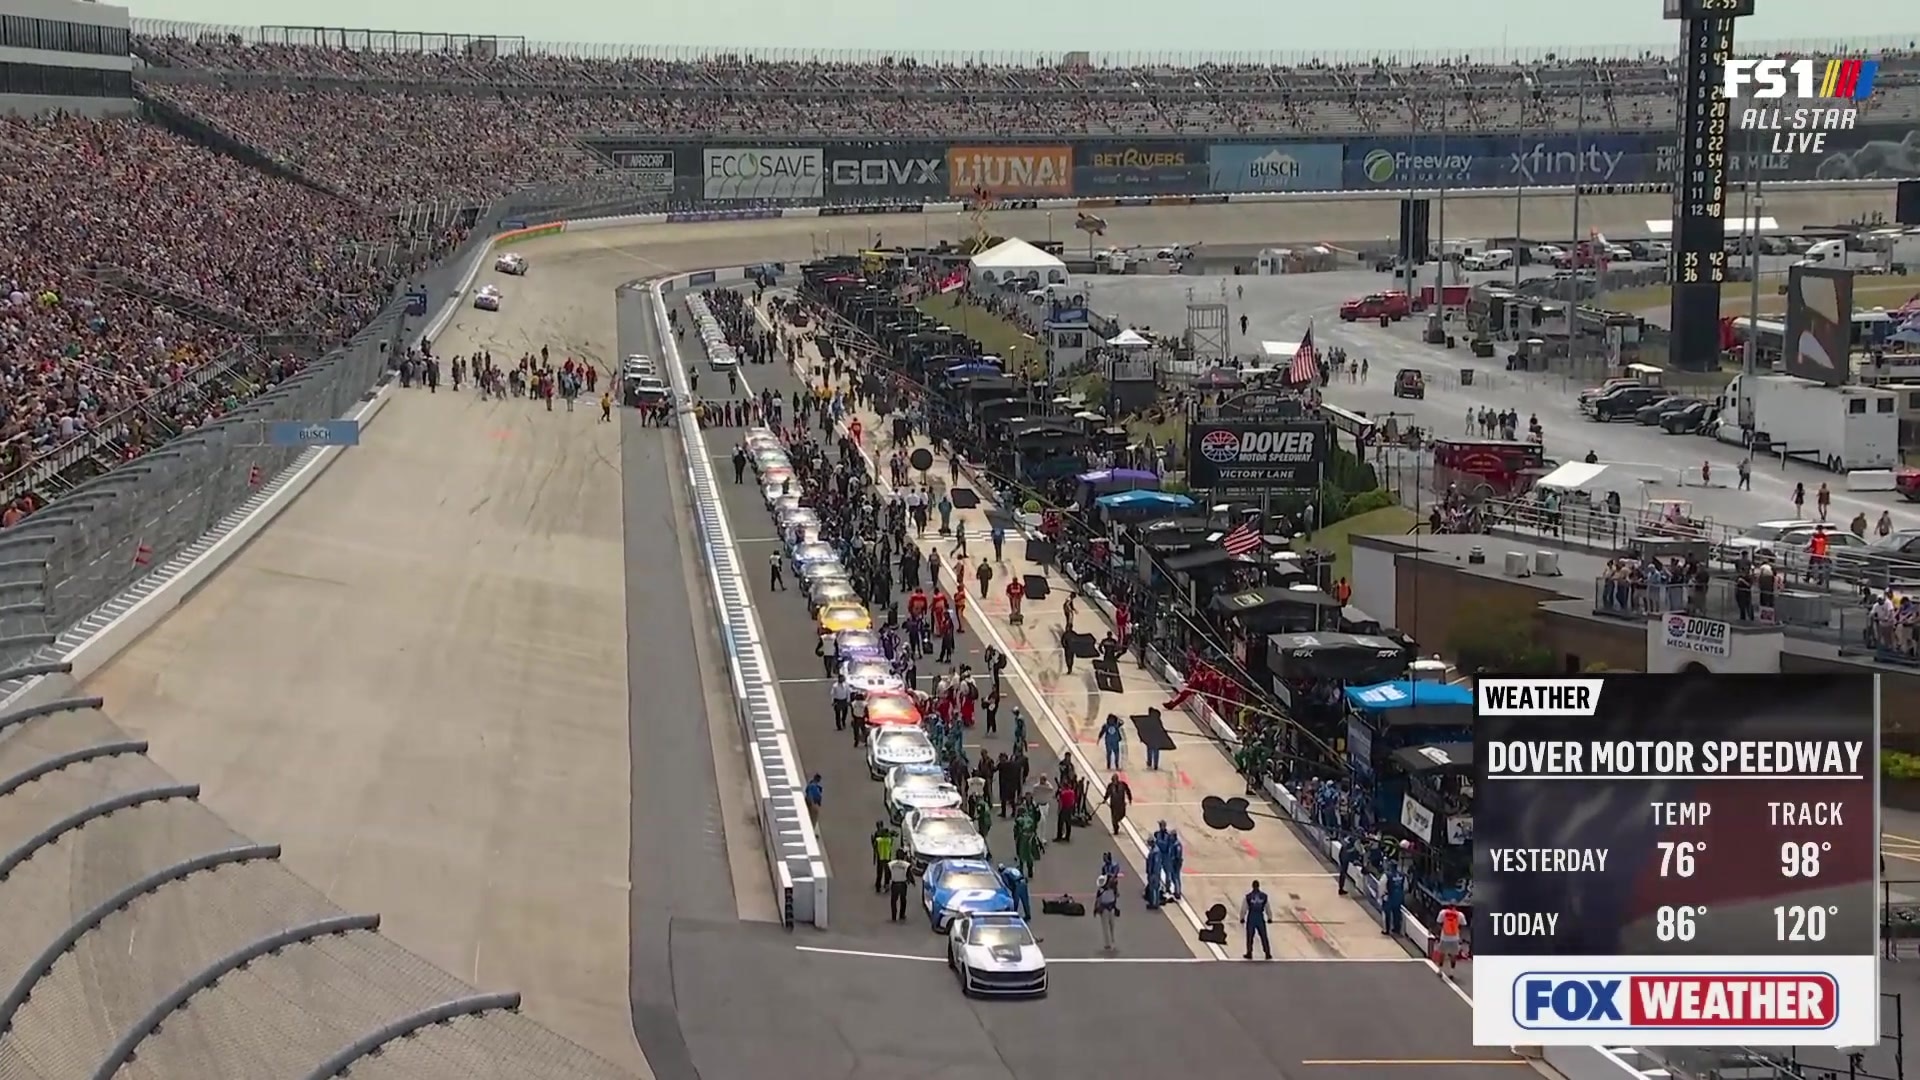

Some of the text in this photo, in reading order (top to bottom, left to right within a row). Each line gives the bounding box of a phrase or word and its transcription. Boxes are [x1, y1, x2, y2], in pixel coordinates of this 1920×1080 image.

[1703, 18, 1730, 31] 1 11
[1700, 36, 1728, 49] 2 6
[1700, 53, 1707, 65] 3
[1699, 86, 1705, 99] 5
[1698, 102, 1726, 118] 6 20
[1697, 119, 1725, 134] 7 23
[1696, 136, 1724, 151] 8 22
[631, 154, 665, 168] NASCAR
[711, 153, 815, 179] ECOSAVE
[1396, 152, 1473, 172] Freeway
[1510, 143, 1624, 183] xfinity
[1695, 154, 1702, 167] 9
[1708, 153, 1723, 168] 54
[833, 159, 941, 186] GOVX
[1250, 162, 1300, 178] BUSCH
[1692, 169, 1722, 184] 10 2
[1692, 186, 1721, 201] 11 8
[1691, 203, 1721, 218] 12 48
[1684, 251, 1724, 267] 35 42
[1684, 268, 1723, 283] 36 16
[300, 430, 331, 440] BUSCH
[1241, 431, 1315, 453] DOVER
[1239, 453, 1313, 463] MOTOR SPEEDWAY
[1219, 470, 1295, 480] VICTORY LANE
[1687, 619, 1726, 639] DOVER
[1667, 639, 1725, 655] MEDIA CENTER
